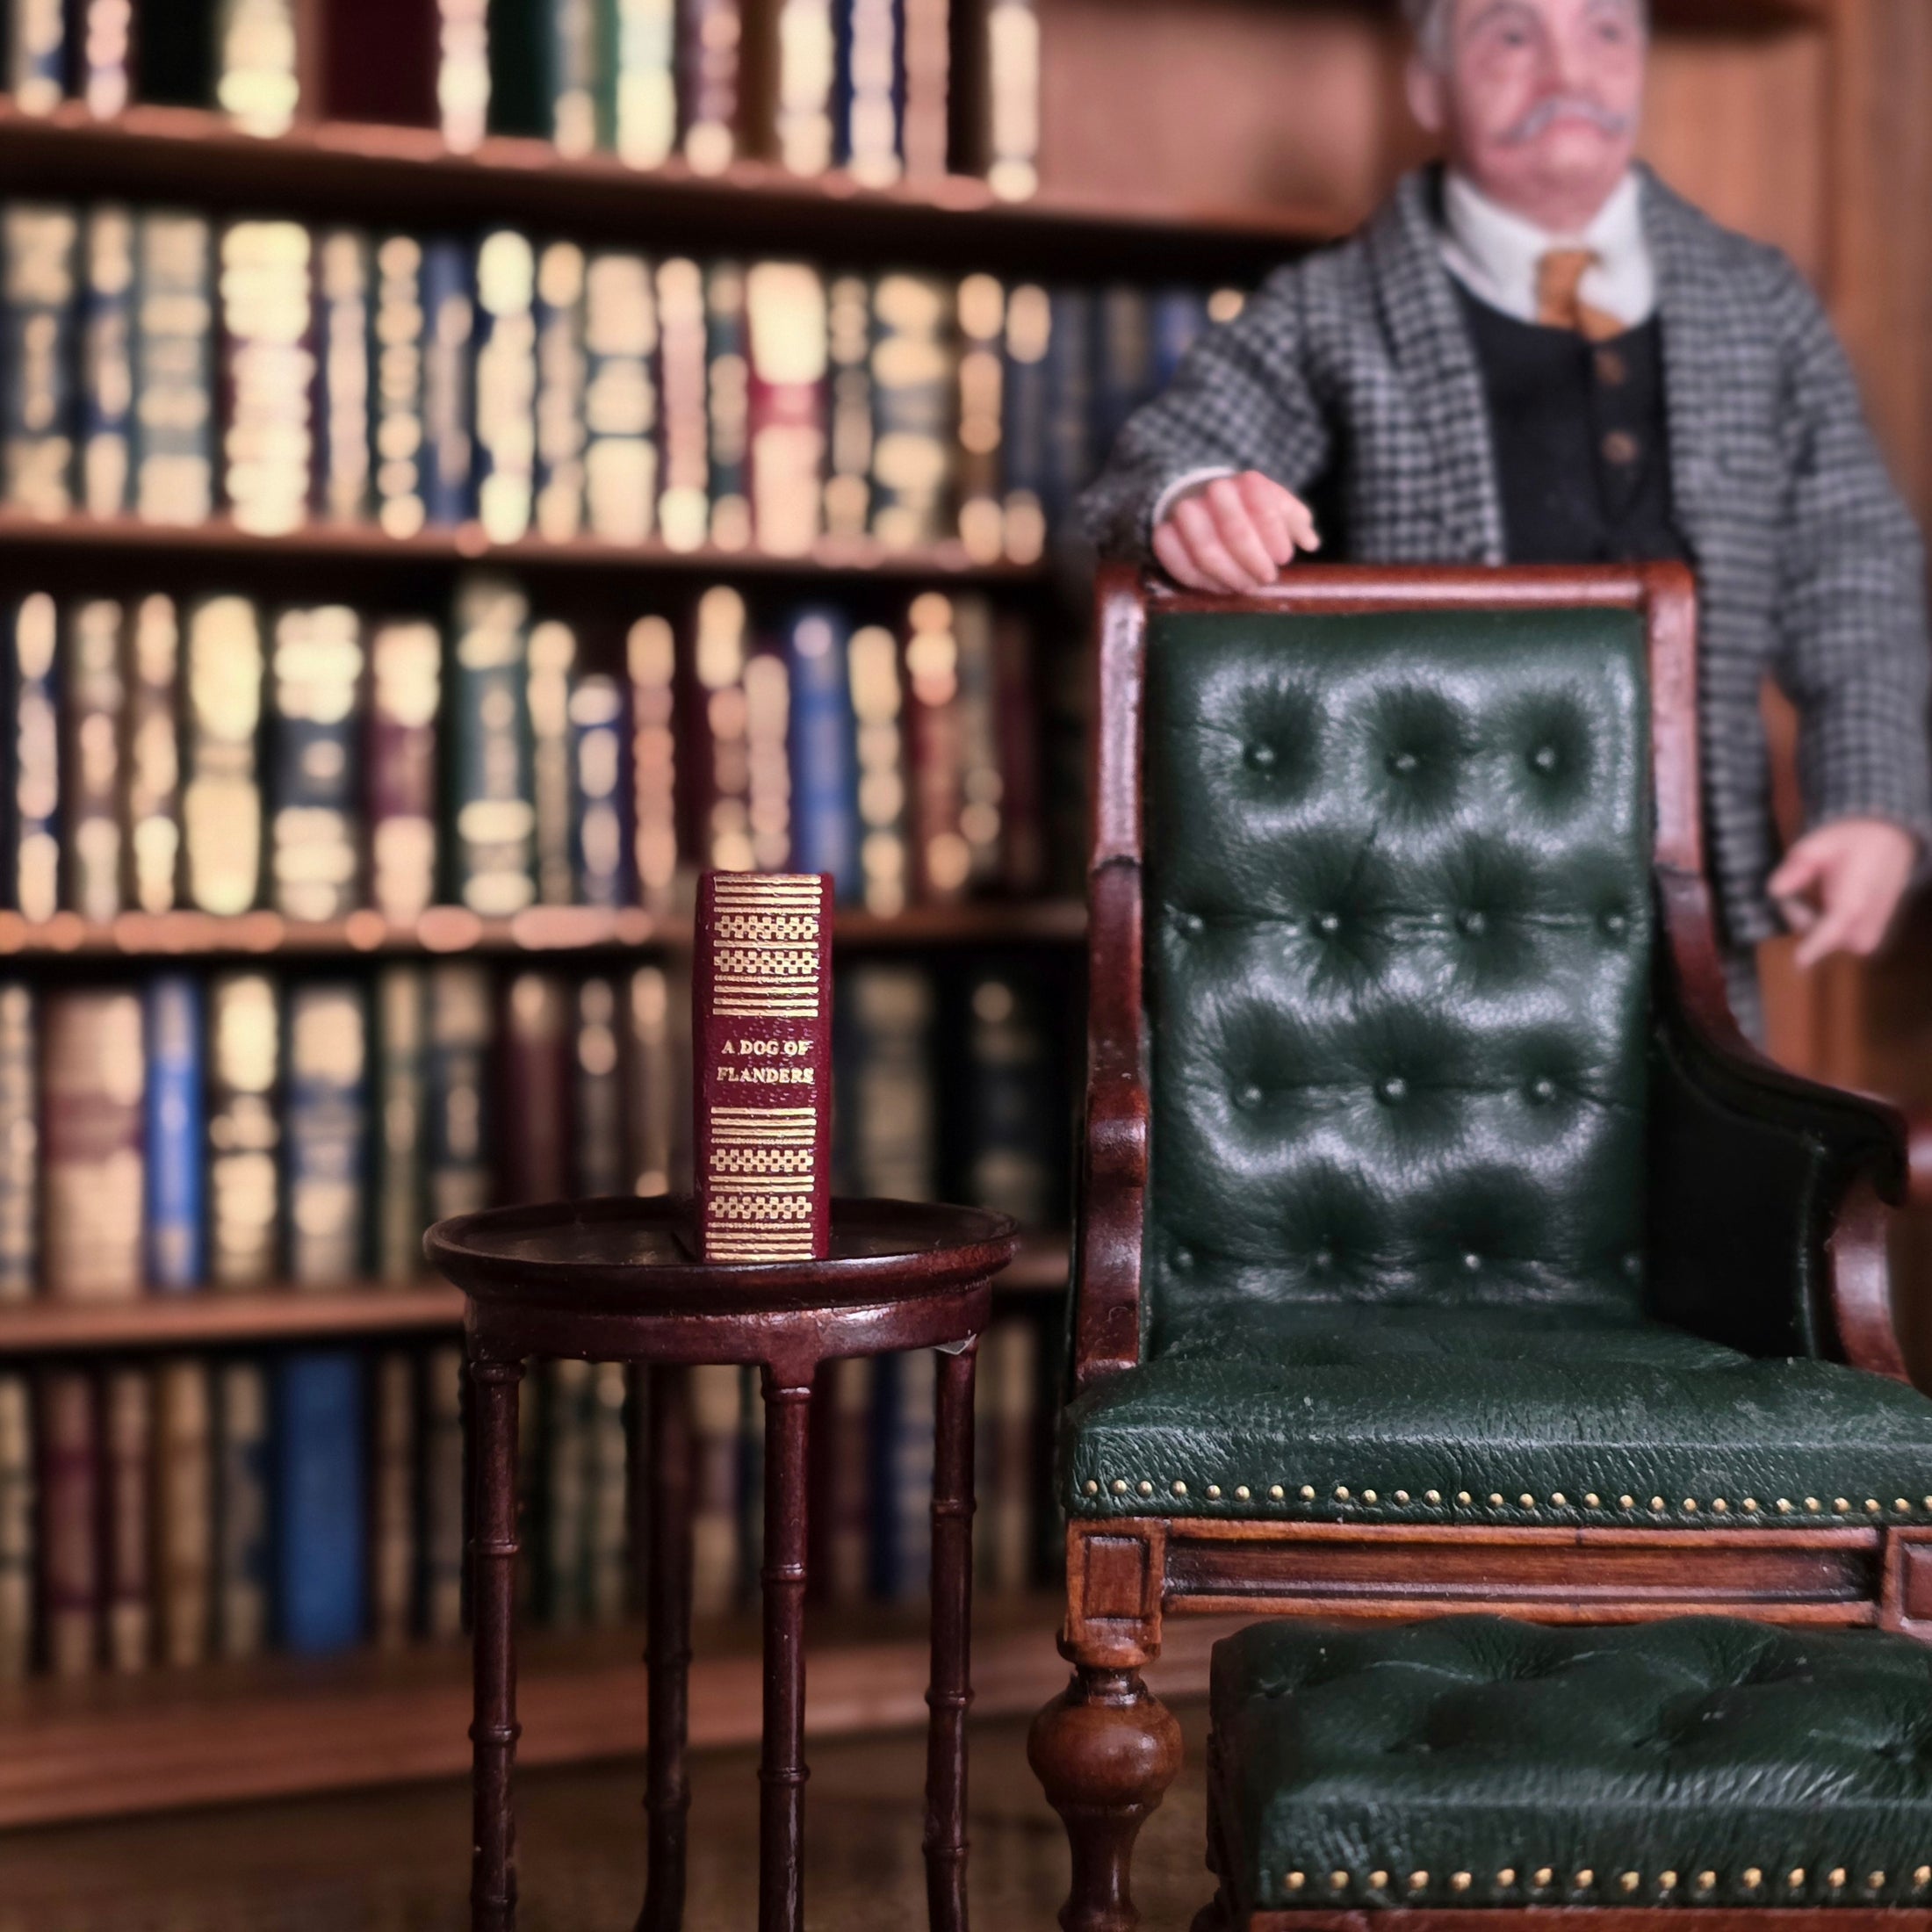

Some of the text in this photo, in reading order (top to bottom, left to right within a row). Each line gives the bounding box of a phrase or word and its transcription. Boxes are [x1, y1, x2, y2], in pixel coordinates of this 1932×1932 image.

[721, 1039, 813, 1056] A DOG OF
[717, 1067, 815, 1084] FLANDERS
